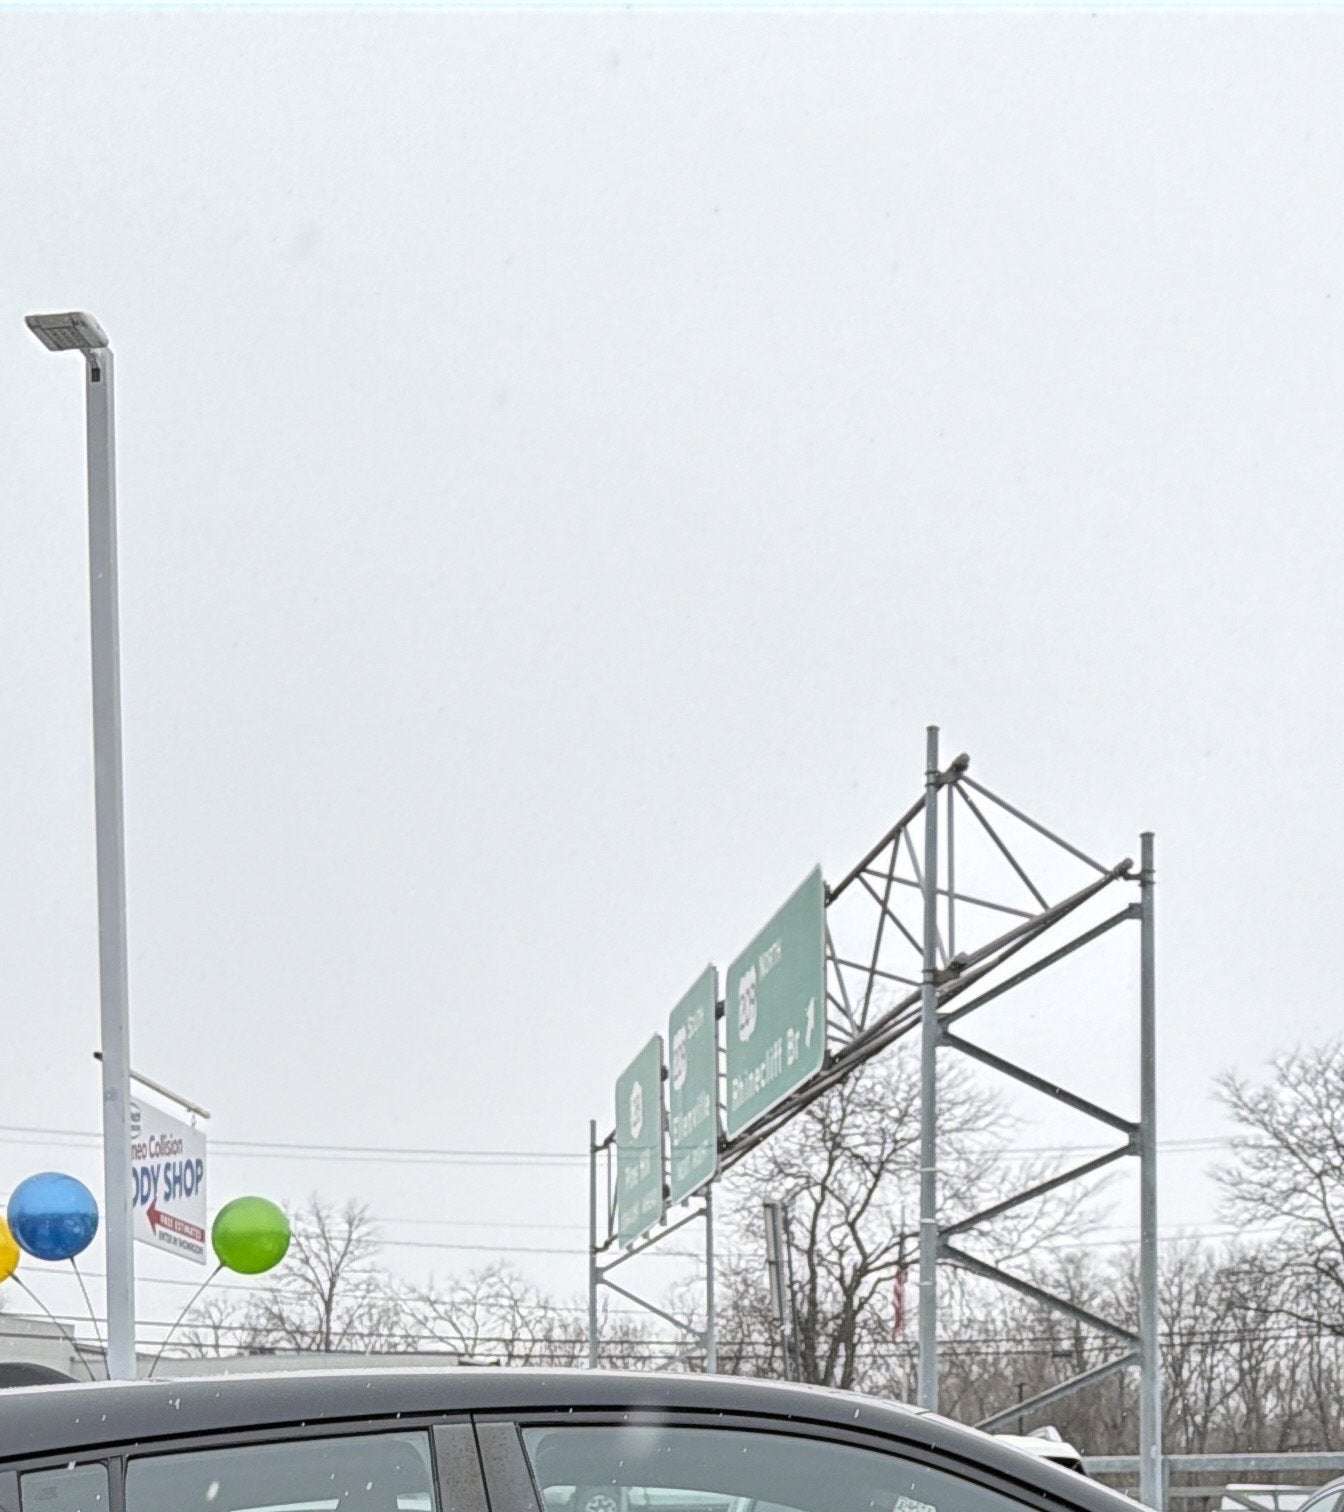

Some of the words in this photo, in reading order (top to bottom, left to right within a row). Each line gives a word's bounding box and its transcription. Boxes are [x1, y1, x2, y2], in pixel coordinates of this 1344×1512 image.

[149, 1133, 183, 1158] Collision
[132, 1164, 161, 1208] ODY
[164, 1158, 204, 1202] SHOP
